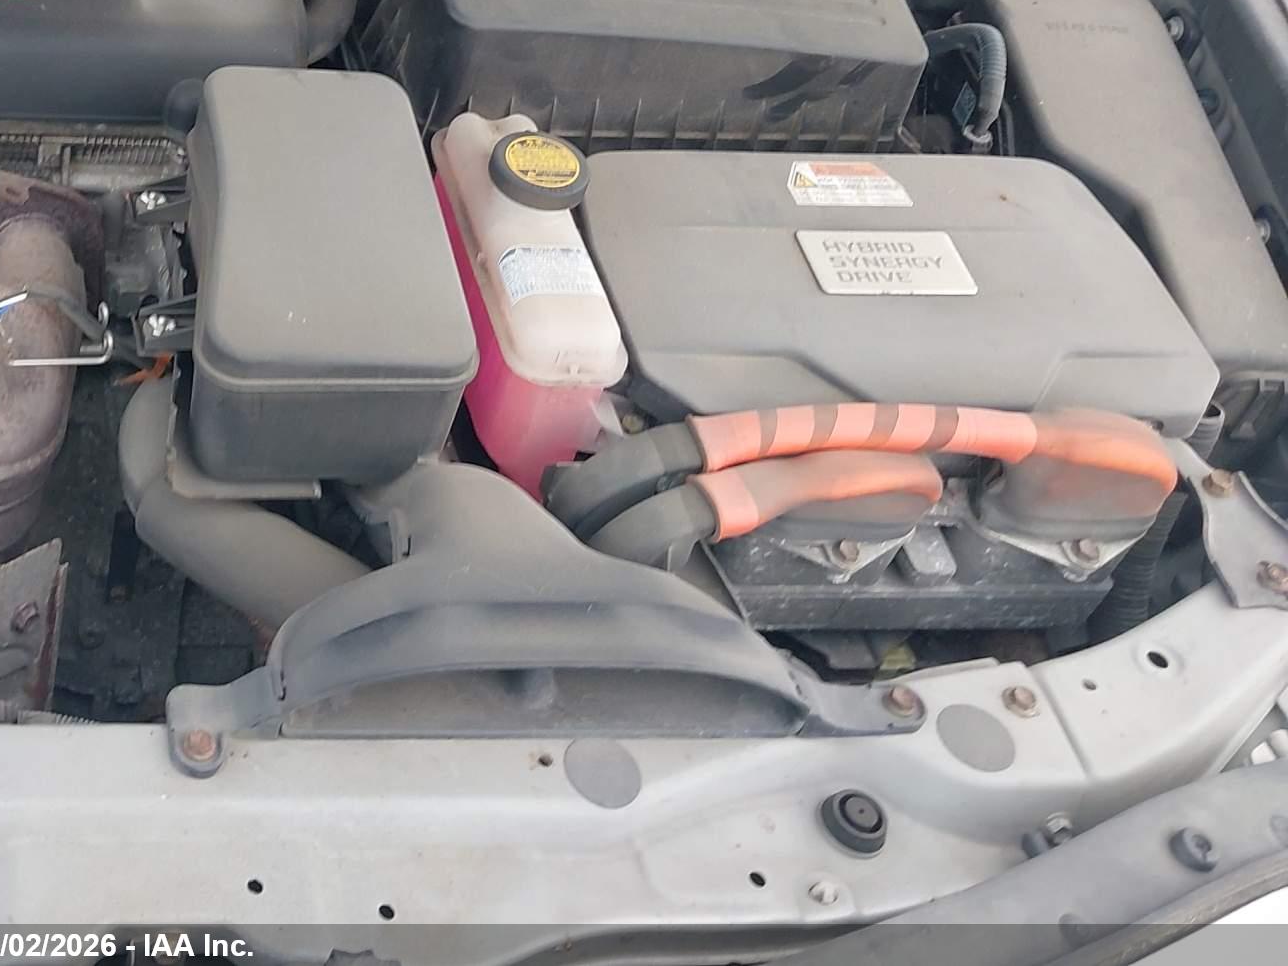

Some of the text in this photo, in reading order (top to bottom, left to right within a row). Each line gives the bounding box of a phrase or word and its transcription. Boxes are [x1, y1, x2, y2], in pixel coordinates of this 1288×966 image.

[821, 240, 916, 254] HYBRID
[829, 256, 944, 270] SYNERGY
[837, 270, 914, 284] DRIVE
